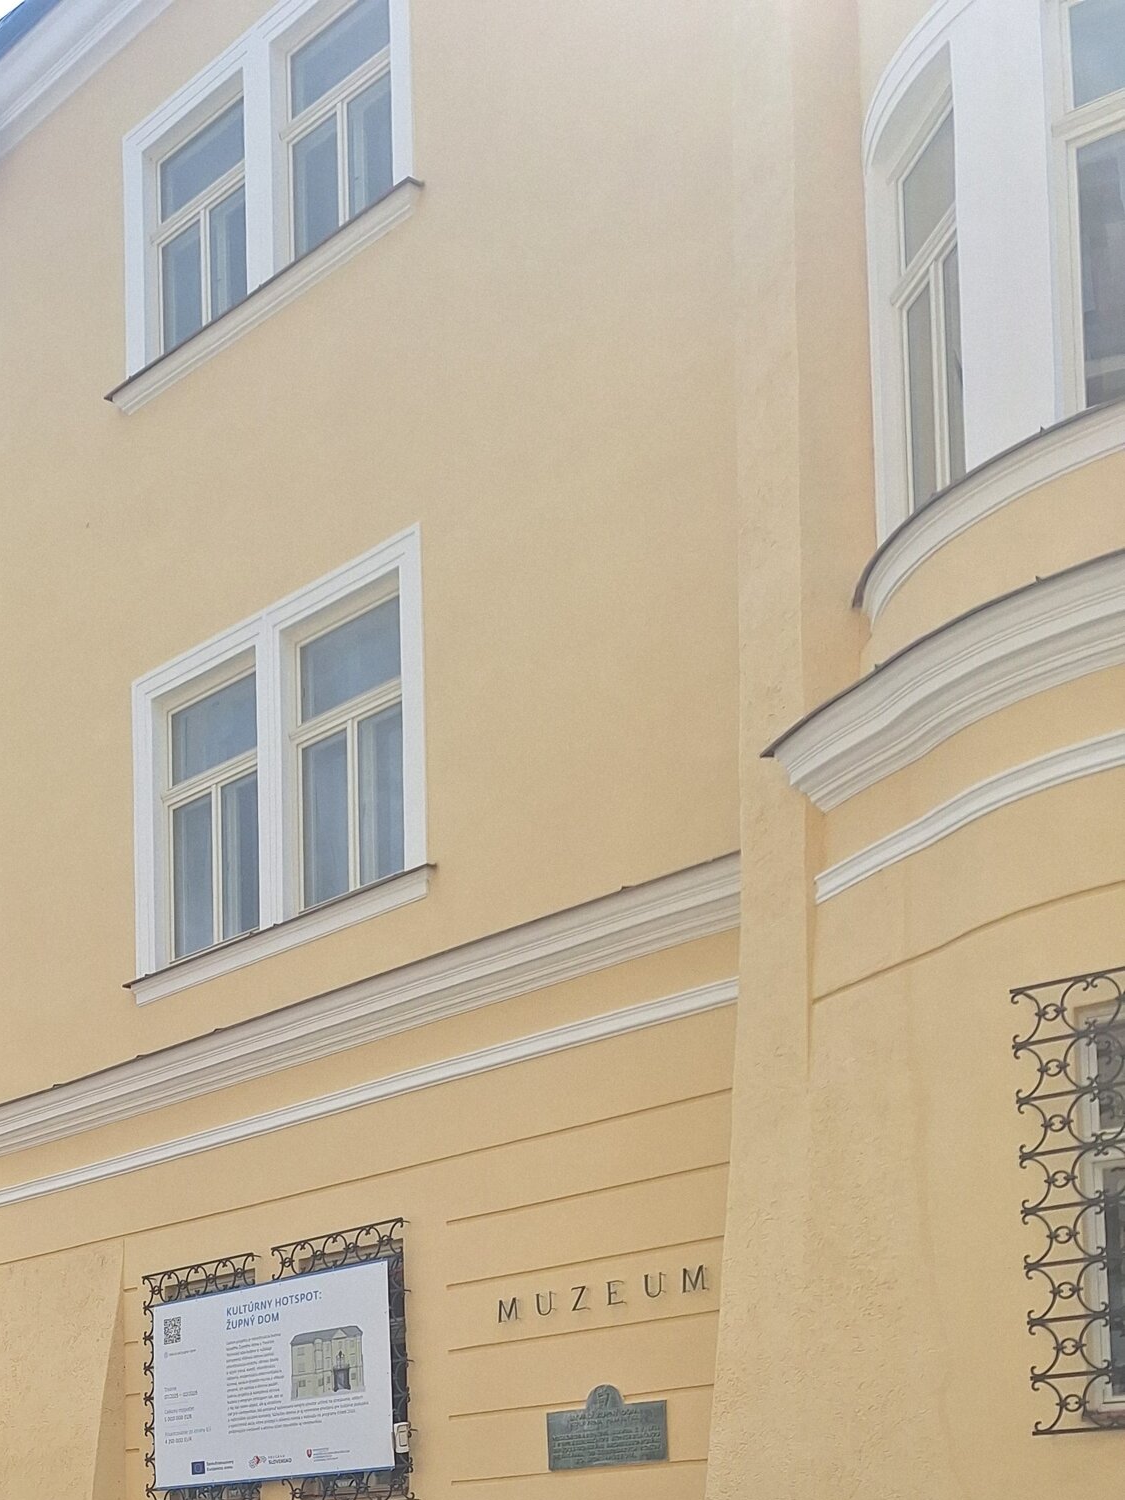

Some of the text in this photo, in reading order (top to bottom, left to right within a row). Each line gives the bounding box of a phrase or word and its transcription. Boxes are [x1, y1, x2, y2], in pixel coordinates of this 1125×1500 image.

[226, 1289, 322, 1317] KULTÚRNY HOTSPOT:
[497, 1264, 708, 1324] MUZEUM
[226, 1312, 280, 1331] ŽUPNÝ DOM
